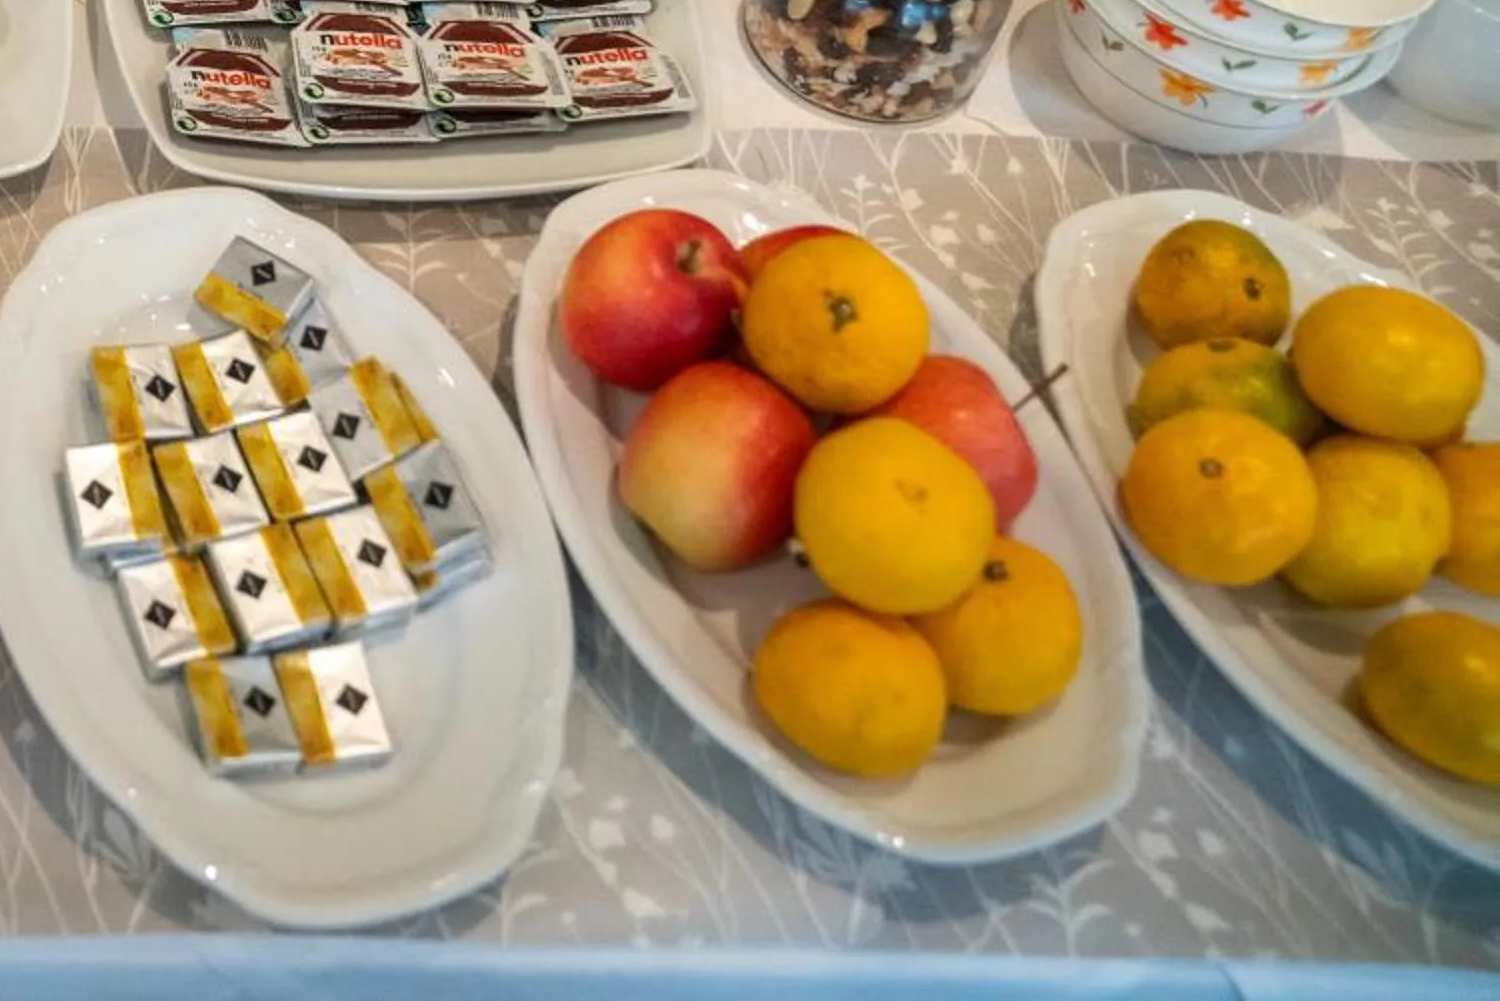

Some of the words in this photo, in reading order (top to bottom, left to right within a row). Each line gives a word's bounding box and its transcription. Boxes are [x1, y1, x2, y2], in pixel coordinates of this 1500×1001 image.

[320, 33, 402, 50] nutella
[445, 42, 525, 58] nutella
[567, 47, 648, 66] nutella
[192, 70, 271, 89] nutella
